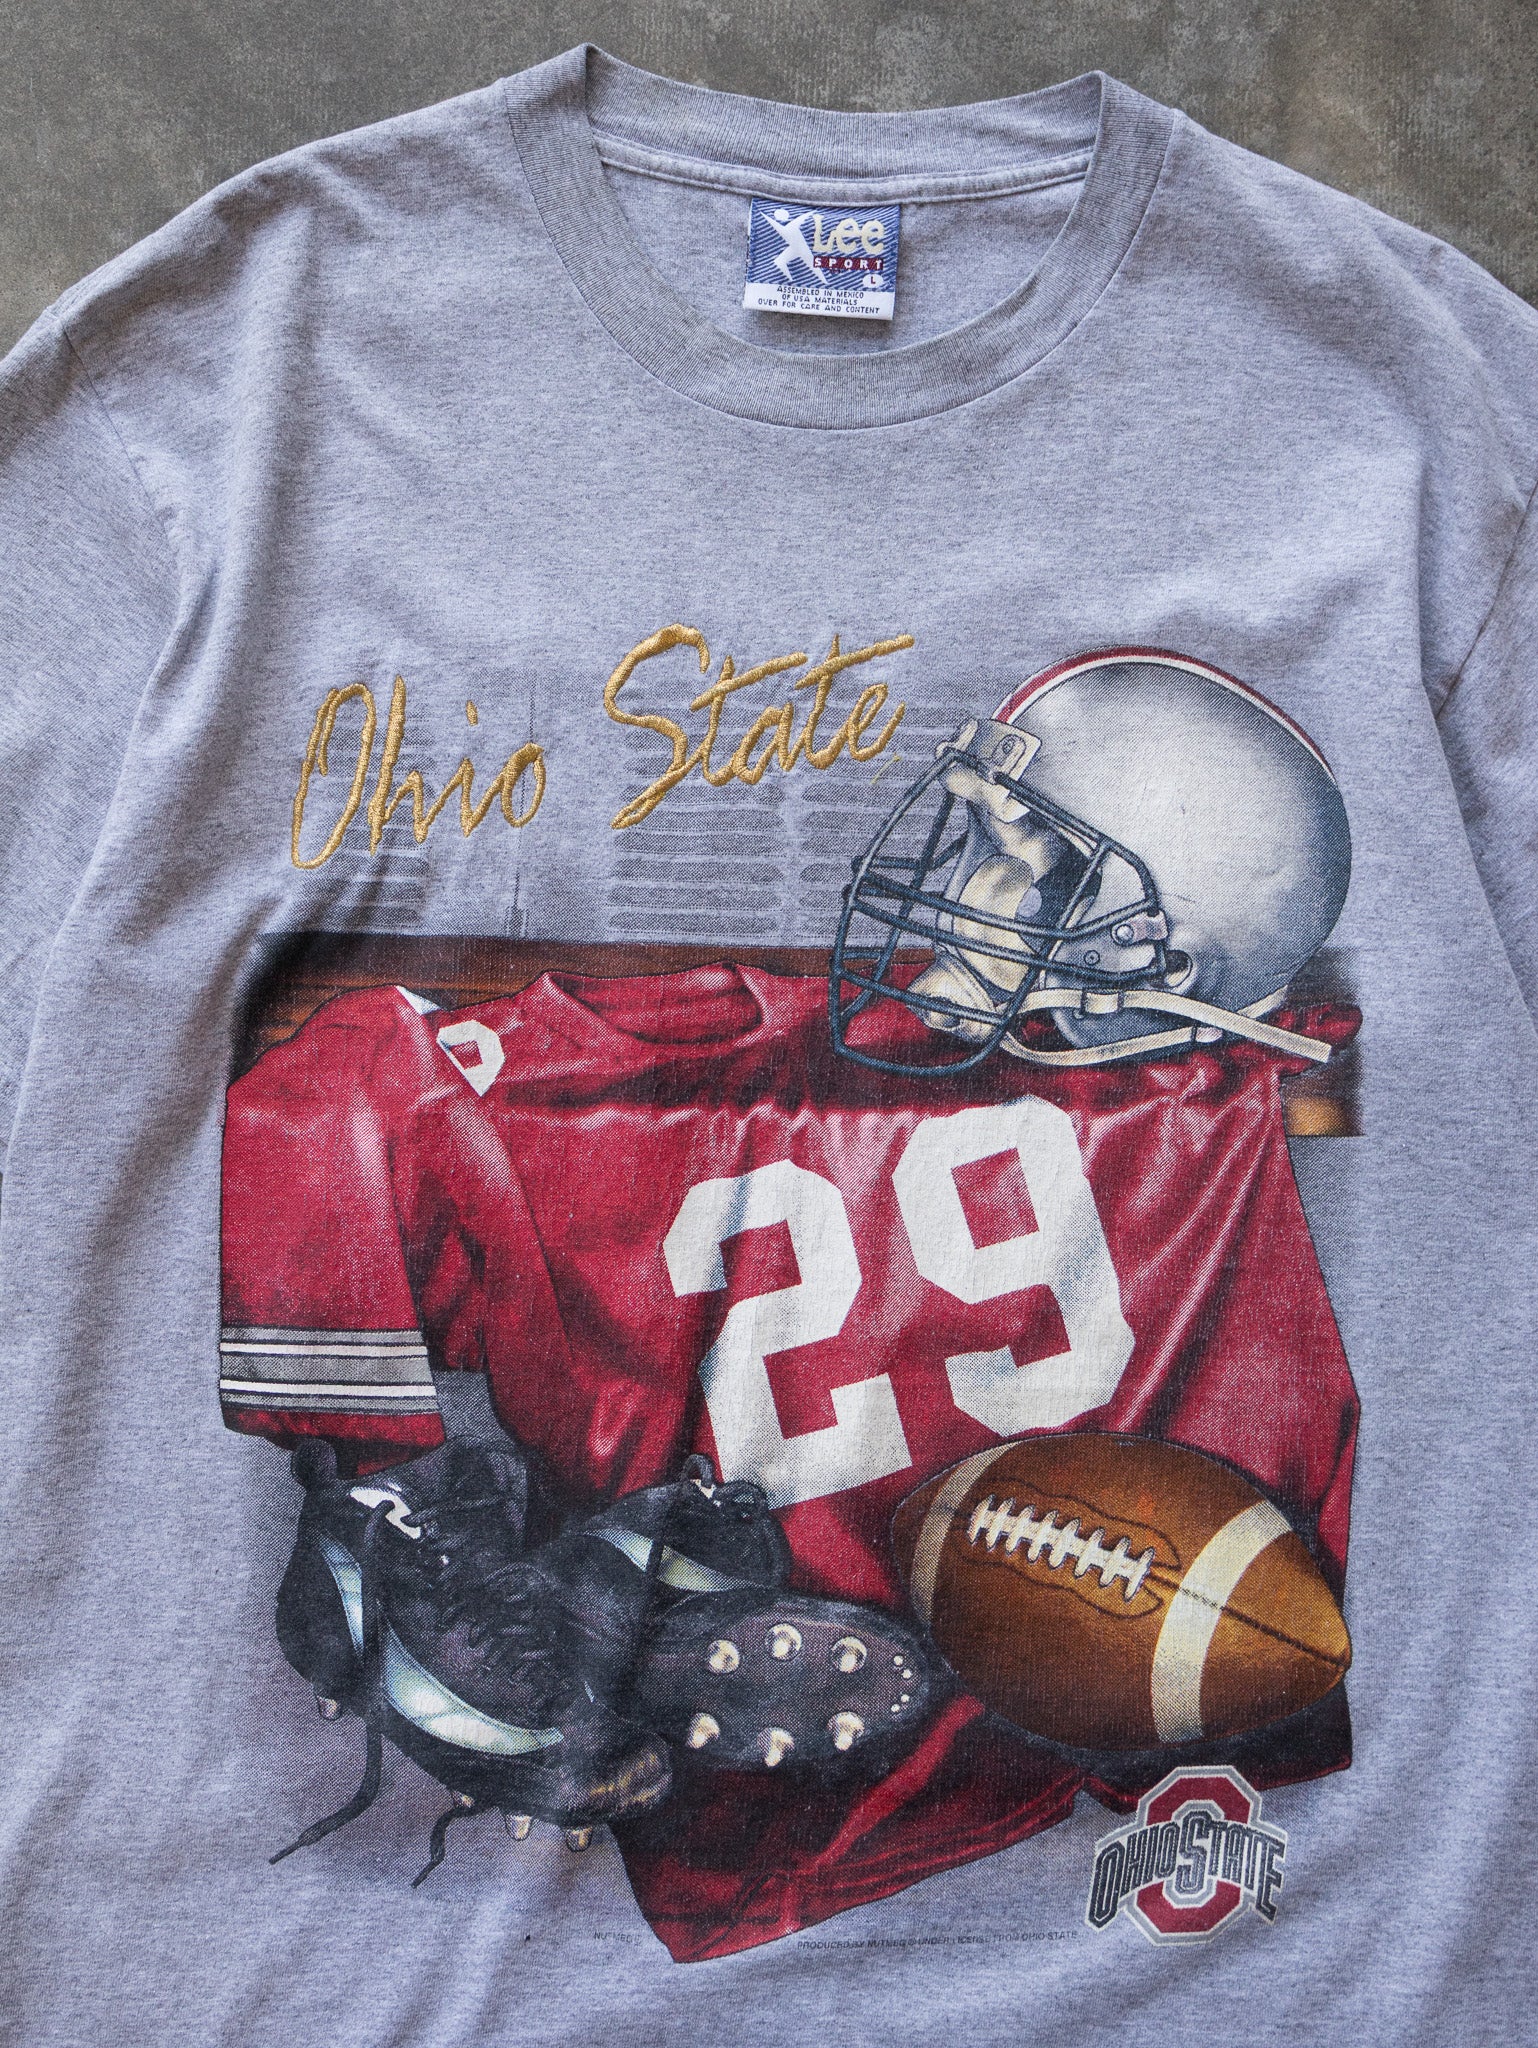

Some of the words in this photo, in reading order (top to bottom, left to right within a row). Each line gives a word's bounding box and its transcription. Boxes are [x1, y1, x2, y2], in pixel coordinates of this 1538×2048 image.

[812, 213, 885, 254] Lee
[814, 257, 882, 270] SPORT
[870, 276, 876, 285] L
[777, 286, 820, 296] ASSEMBLED
[824, 289, 832, 297] IN
[836, 290, 864, 299] MEXICO
[758, 298, 778, 307] OVER
[782, 300, 796, 309] FOR
[800, 303, 820, 311] CARE
[825, 304, 841, 312] AND
[845, 306, 880, 314] CONTENT
[793, 295, 810, 303] USA
[814, 297, 858, 306] MATERIALS
[292, 676, 544, 869] Ohio
[604, 624, 914, 830] State
[663, 1094, 1135, 1510] 29
[1087, 1821, 1181, 1930] OHIO
[1173, 1809, 1287, 1922] STATE
[1021, 1932, 1045, 1942] OHIO
[1047, 1930, 1078, 1941] STATE
